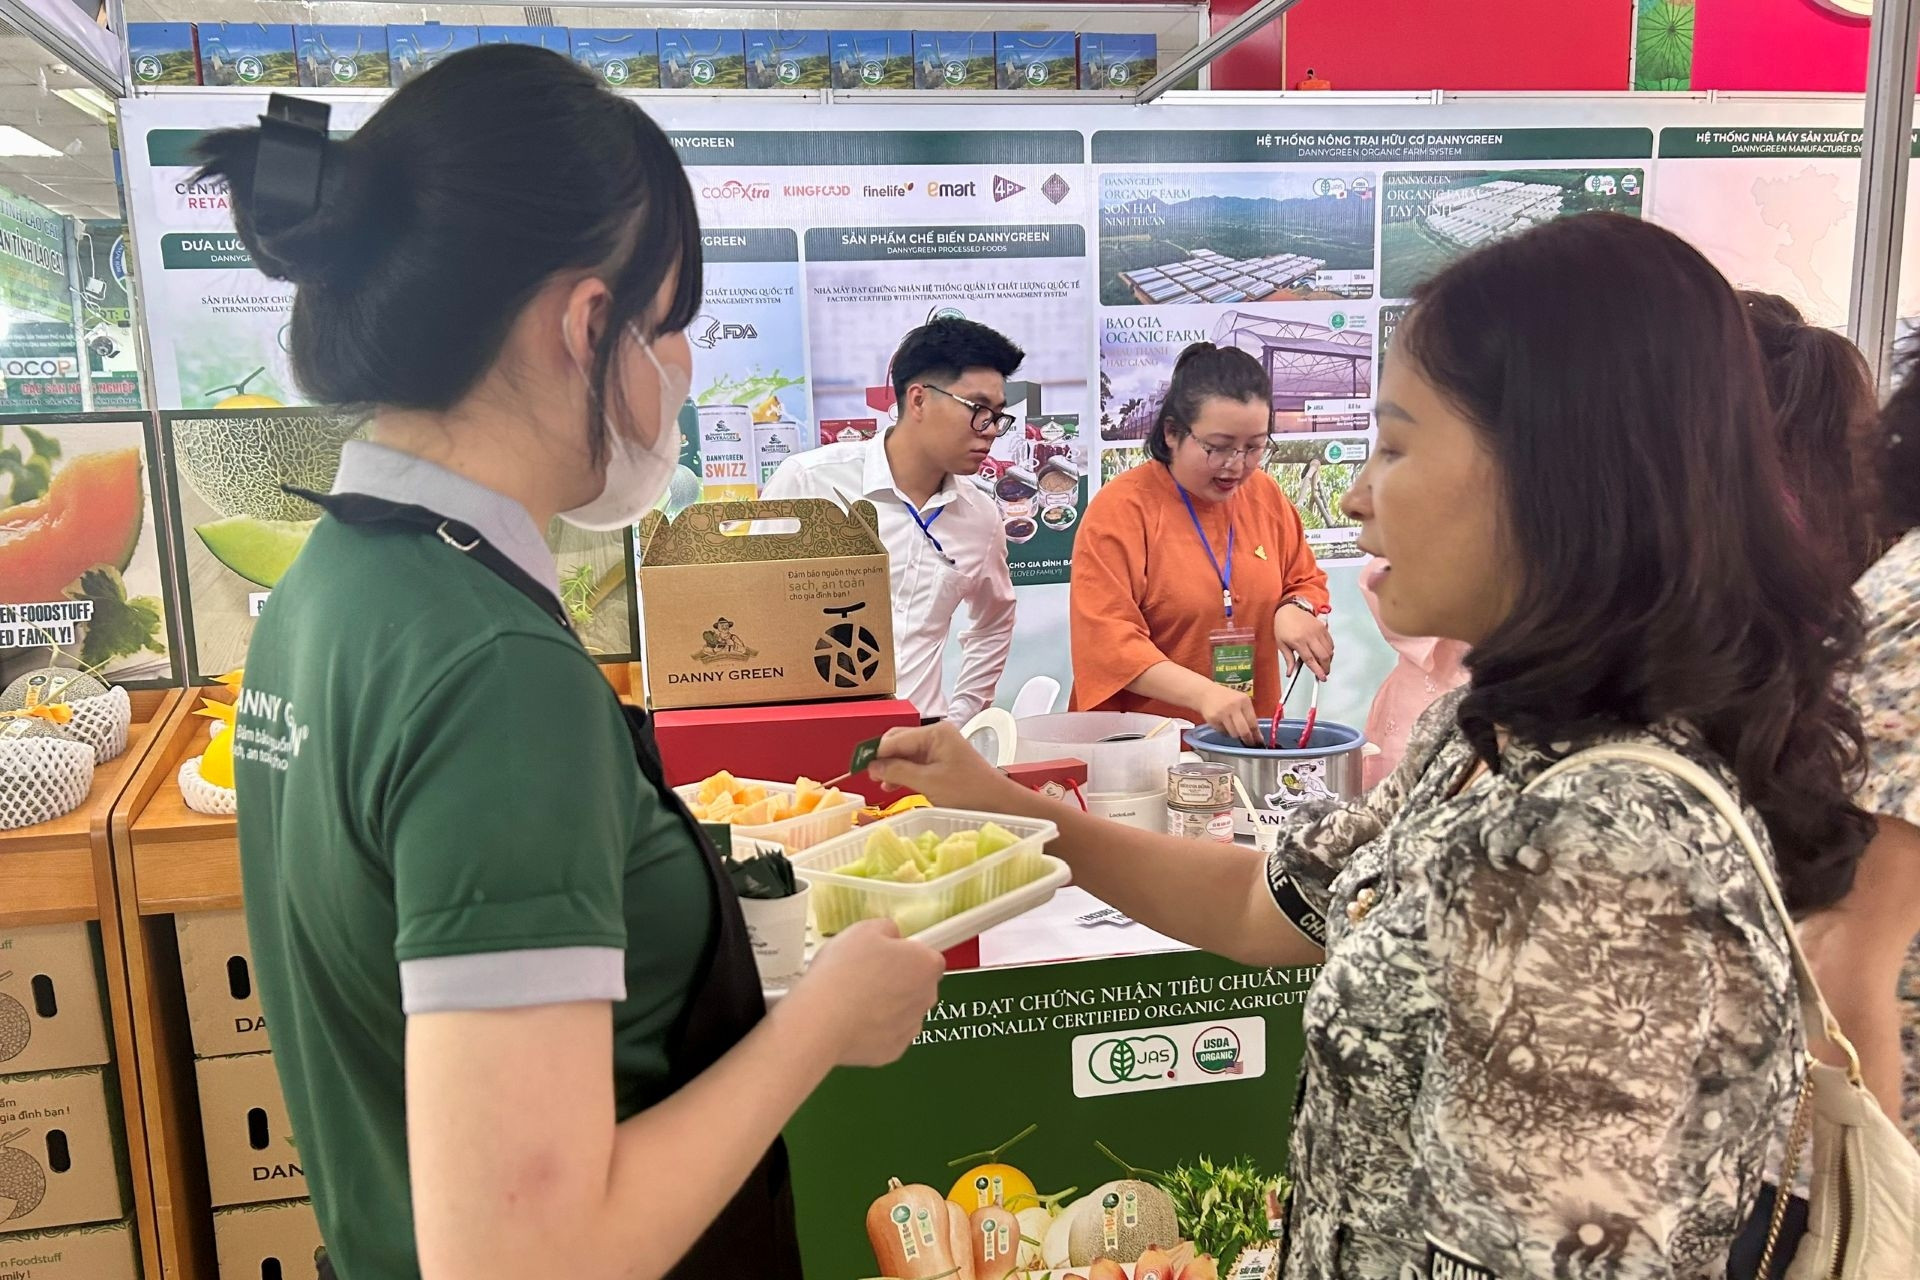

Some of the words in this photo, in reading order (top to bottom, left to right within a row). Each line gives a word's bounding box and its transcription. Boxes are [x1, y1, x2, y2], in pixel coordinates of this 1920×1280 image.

[1256, 134, 1272, 148] HỆ
[1274, 133, 1315, 146] THỐNG
[1317, 134, 1350, 146] NÔNG
[1353, 135, 1378, 147] TRẠI
[1381, 134, 1406, 145] HỮU
[1408, 135, 1425, 145] CƠ
[1427, 134, 1503, 145] DANNYGREEN
[1696, 132, 1711, 144] HỆ
[1713, 131, 1750, 143] THỐNG
[1752, 131, 1774, 142] NHÀ
[1776, 131, 1799, 142] MÁY
[1800, 131, 1821, 142] SẢN
[1822, 130, 1850, 142] XUẤT
[1298, 149, 1360, 157] DANNYGREEN
[1361, 148, 1401, 156] ORGANIC
[1403, 148, 1427, 156] FARM
[1429, 147, 1462, 156] SYSTEM
[1731, 144, 1787, 153] DANNYGREEN
[1788, 144, 1853, 153] MANUFACTURER
[1388, 175, 1451, 186] DANNYGREEN
[783, 185, 851, 197] KINGFOOD
[863, 185, 906, 197] finelife
[927, 181, 976, 197] emart
[1104, 189, 1159, 200] ORGANIC
[1160, 188, 1191, 199] FARM
[1387, 190, 1445, 201] ORGANIC
[1387, 204, 1414, 217] TAY
[1417, 204, 1452, 217] NINH
[701, 236, 747, 246] GREEN
[841, 232, 867, 245] SẢN
[870, 231, 906, 244] PHẨM
[909, 230, 934, 244] CHẾ
[937, 230, 965, 243] BIẾN
[968, 231, 1050, 243] DANNYGREEN
[181, 238, 214, 251] DƯA
[887, 246, 937, 254] DANNYGREEN
[982, 245, 1008, 253] FOODS
[705, 286, 728, 296] CHẤT
[729, 287, 758, 297] LƯỢNG
[758, 286, 781, 296] QUỐC
[783, 286, 794, 295] TẾ
[813, 287, 831, 295] NHÀ
[832, 285, 850, 294] MÁY
[898, 284, 921, 293] NHẬN
[922, 283, 933, 293] HỆ
[933, 282, 962, 292] THỐNG
[963, 281, 986, 291] QUẢN
[987, 281, 996, 291] LÝ
[997, 281, 1019, 291] CHẤT
[1019, 281, 1046, 291] LƯỢNG
[1047, 280, 1070, 290] QUỐC
[1071, 279, 1080, 289] TẾ
[912, 293, 966, 301] INTERNATIONAL
[966, 292, 996, 301] QUALITY
[996, 291, 1043, 299] MANAGEMENT
[1043, 290, 1068, 298] SYSTEM
[1106, 317, 1135, 329] BAO
[1137, 316, 1162, 329] GIA
[723, 323, 758, 339] FDA
[1106, 330, 1164, 344] OGANIC
[1166, 329, 1206, 342] FARM
[7, 360, 71, 376] OCOP
[706, 454, 744, 462] DANNYGREEN
[705, 463, 748, 478] SWIZZ
[1009, 561, 1026, 569] CHO
[1042, 559, 1062, 568] ĐÌNH
[788, 571, 806, 579] Đảm
[806, 569, 821, 578] bảo
[821, 568, 844, 579] nguồn
[845, 567, 862, 576] thực
[863, 566, 883, 576] phẩm
[822, 580, 836, 590] an
[839, 577, 865, 589] toàn
[789, 592, 803, 601] cho
[803, 592, 815, 601] gia
[815, 590, 832, 599] đình
[20, 602, 91, 622] FOODSTUFF
[18, 626, 72, 645] FAMILY!
[668, 671, 724, 684] DANNY
[728, 667, 784, 681] GREEN
[972, 997, 1014, 1019] ĐẠT
[1019, 989, 1096, 1012] CHỨNG
[1101, 981, 1162, 1004] NHẬN
[1168, 975, 1214, 997] TIÊU
[1218, 967, 1291, 991] CHUẨN
[1052, 1007, 1140, 1030] CERTIFIED
[1144, 999, 1226, 1019] ORGANIC
[1203, 1037, 1230, 1049] USDA
[1137, 1049, 1170, 1065] JAS
[1200, 1050, 1234, 1062] ORGANIC
[0, 1112, 16, 1124] gia
[18, 1108, 42, 1120] đình
[44, 1108, 64, 1118] bạn
[10, 1252, 62, 1268] Foodstuff
